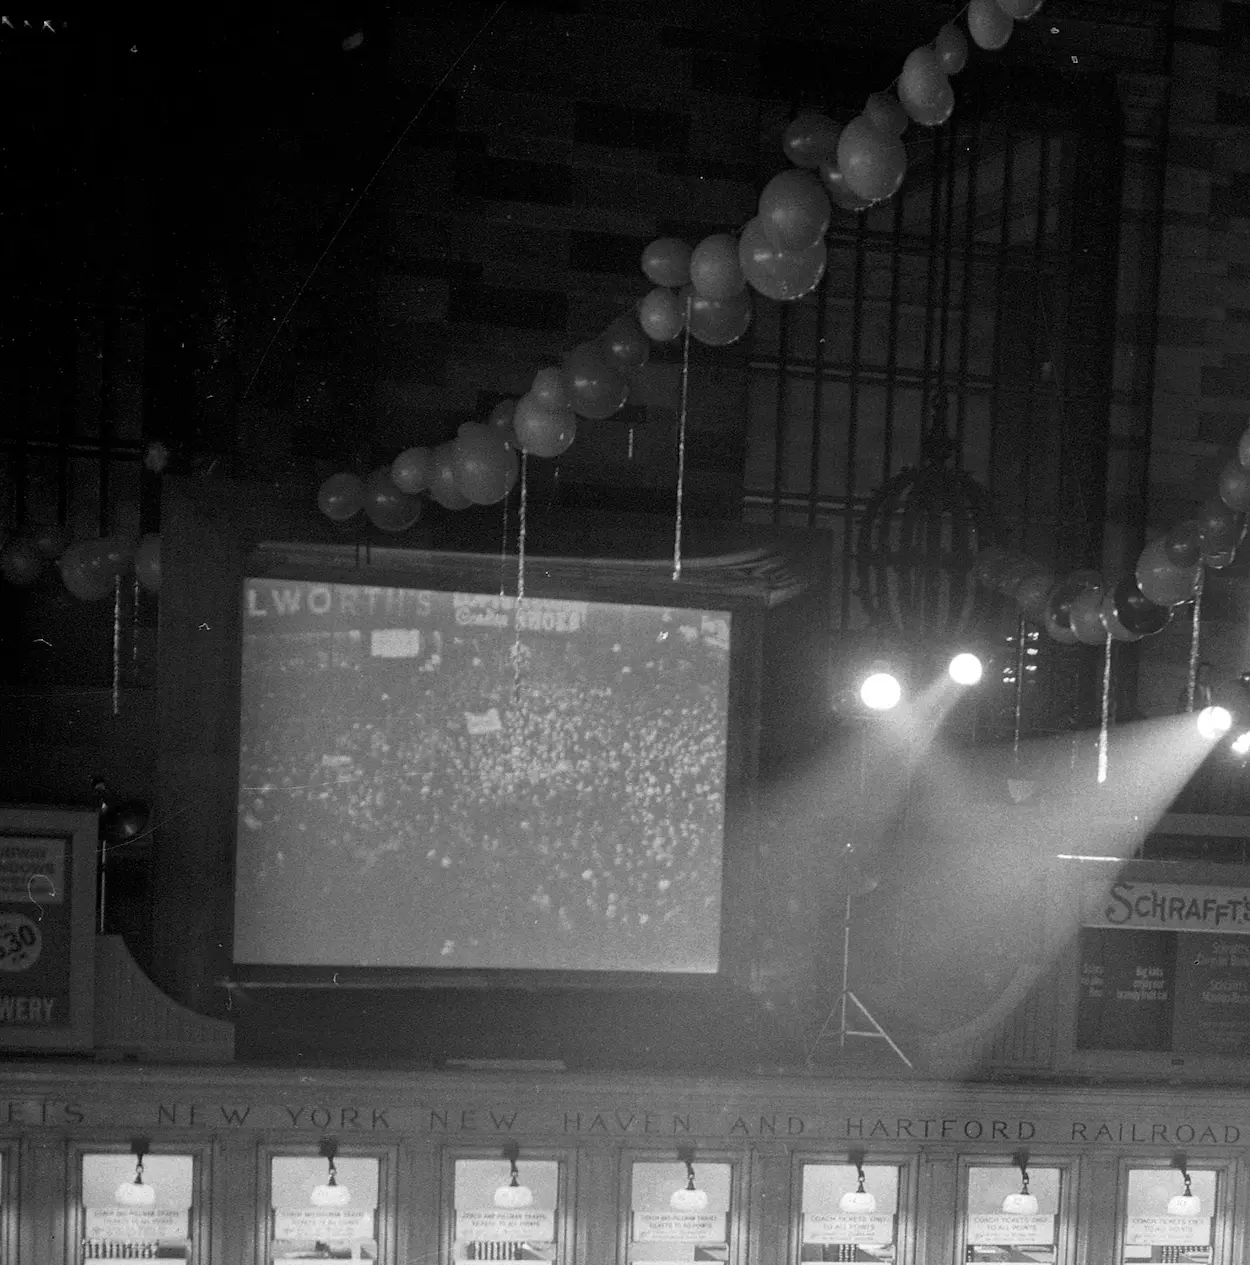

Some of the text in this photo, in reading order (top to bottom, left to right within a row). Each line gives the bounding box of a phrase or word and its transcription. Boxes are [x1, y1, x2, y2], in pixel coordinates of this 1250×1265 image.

[158, 1104, 250, 1125] NEW
[286, 1107, 390, 1129] YORK
[430, 1110, 518, 1130] NEW
[564, 1113, 690, 1132] HAVEN
[730, 1115, 805, 1135] AND
[846, 1117, 1036, 1140] HARTFORD
[1072, 1122, 1241, 1144] RAILROAD
